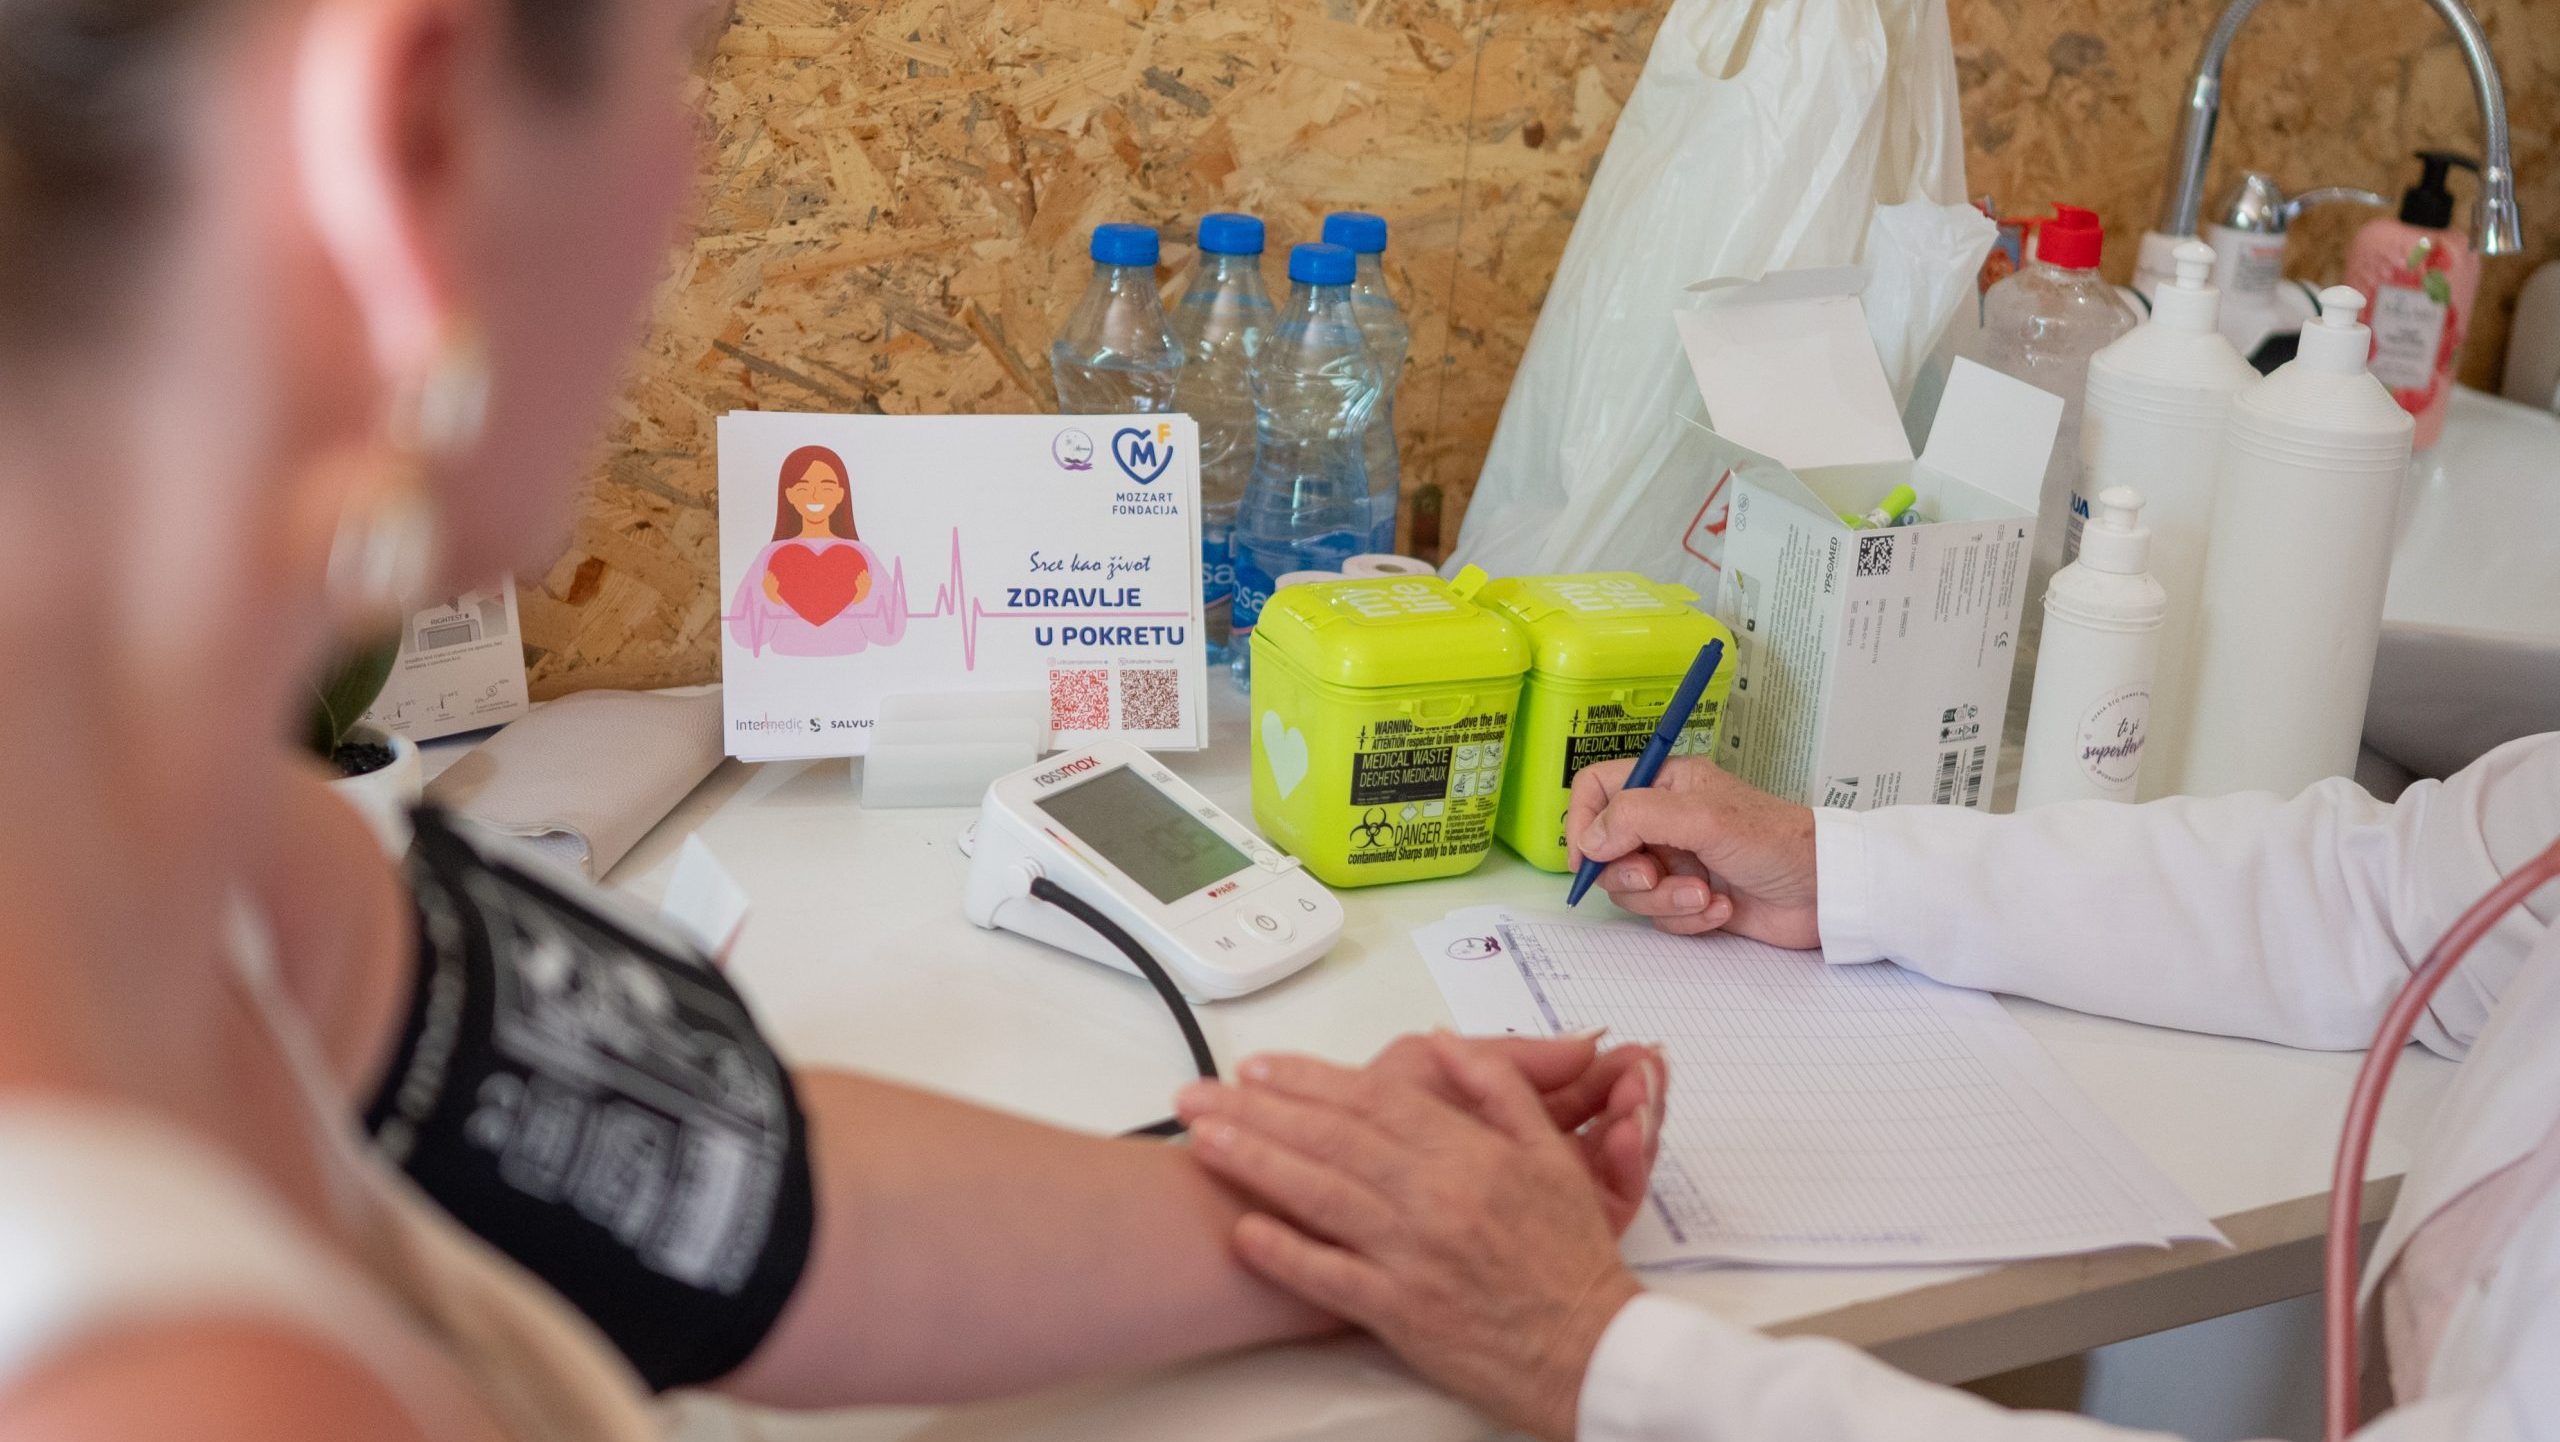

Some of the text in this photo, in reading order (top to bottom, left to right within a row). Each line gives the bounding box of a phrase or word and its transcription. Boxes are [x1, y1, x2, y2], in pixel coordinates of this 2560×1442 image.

[1130, 441, 1157, 467] M
[1116, 493, 1173, 502] MOZZART
[1112, 505, 1178, 515] FONDACIJA
[1030, 551, 1151, 580] Srce kao život
[1824, 536, 1838, 594] YPSOMED
[1007, 588, 1142, 607] ZDRAVLJE
[1035, 626, 1184, 646] U POKRETU
[1705, 699, 1718, 713] line
[736, 716, 803, 732] Intermedic
[831, 720, 875, 729] SALVUS
[1374, 719, 1412, 735] WARNING
[1480, 713, 1493, 727] the
[1494, 712, 1508, 726] line
[1584, 721, 1617, 734] ATTENTION
[1372, 737, 1406, 750] ATTENTION
[1406, 734, 1435, 750] respecter
[1435, 733, 1442, 745] la
[1461, 731, 1470, 743] de
[1574, 735, 1620, 753] MEDICAL
[1362, 748, 1449, 769] MEDICAL WASTE
[1032, 755, 1101, 788] rossmax
[1360, 766, 1446, 787] DECHETS MEDICAUX
[1394, 822, 1442, 847] DANGER
[1348, 848, 1397, 864] contaminated
[1398, 845, 1423, 862] Sharps
[1423, 844, 1440, 861] only
[1440, 844, 1448, 856] to
[1448, 842, 1457, 855] be
[1215, 936, 1236, 951] M
